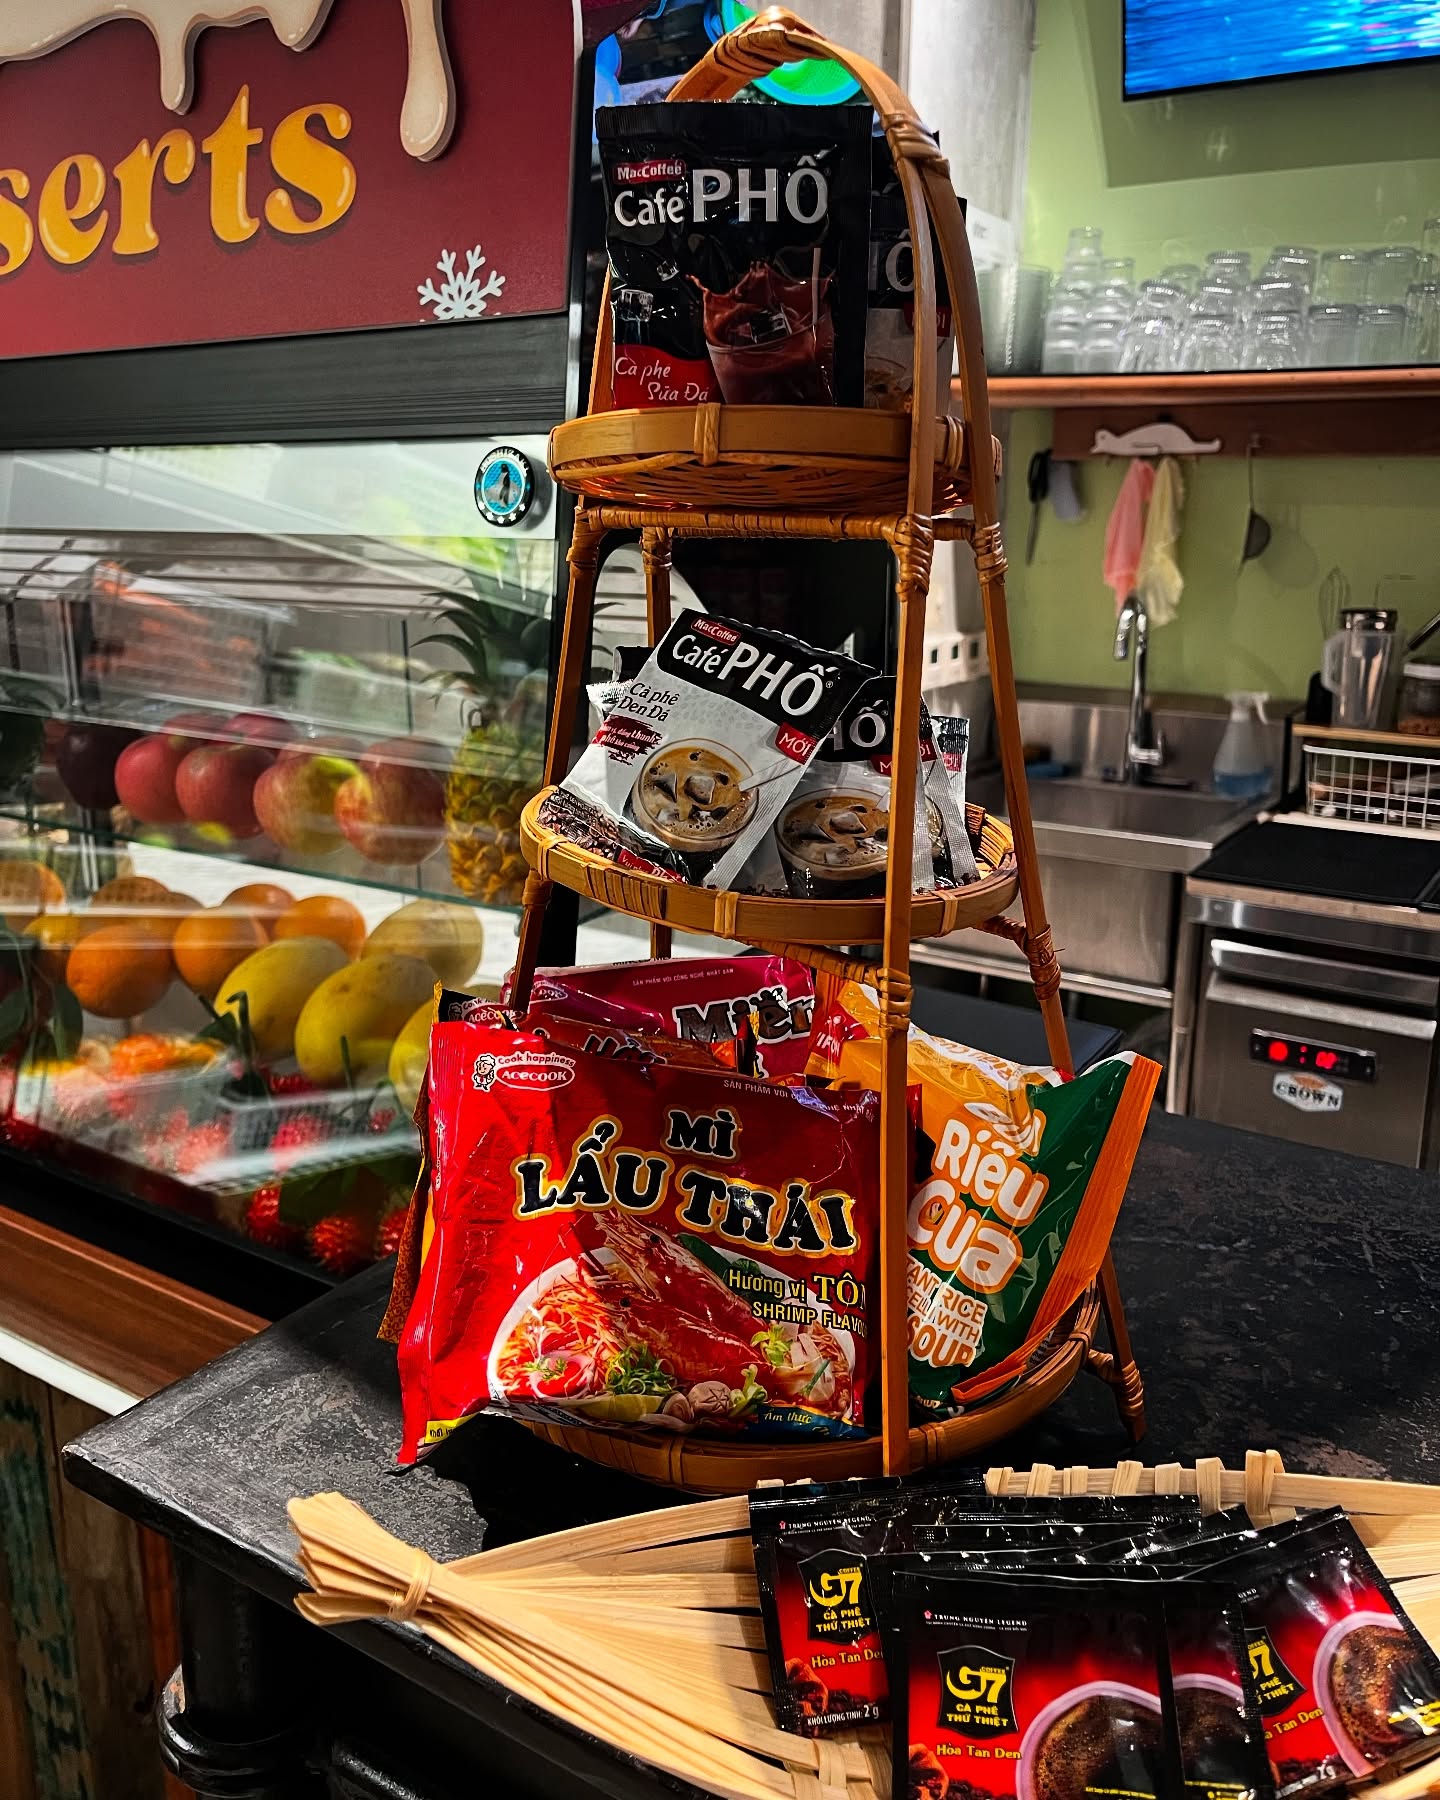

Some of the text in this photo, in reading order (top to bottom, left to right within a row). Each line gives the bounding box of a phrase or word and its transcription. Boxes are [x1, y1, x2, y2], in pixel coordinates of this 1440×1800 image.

[617, 163, 682, 180] MacCoffee
[614, 185, 684, 227] Café
[693, 618, 739, 643] MacCoffee
[672, 634, 839, 717] Café PHỐ
[629, 682, 681, 706] Cà phê
[498, 1052, 575, 1067] Cook happiness
[1276, 1081, 1339, 1107] CROWN
[666, 1108, 738, 1159] MÌ
[728, 1269, 783, 1298] Hương
[790, 1280, 805, 1301] vị
[752, 1301, 816, 1324] SHRIMP
[942, 1287, 986, 1324] RICE
[936, 1310, 980, 1344] WITH
[934, 1614, 960, 1622] TRUNG
[996, 1618, 1028, 1627] LEGEND
[811, 1653, 836, 1669] Hòa
[838, 1652, 861, 1665] Tan
[946, 1666, 1007, 1703] G7
[1273, 1717, 1298, 1735] Tan
[936, 1743, 962, 1756] Hòa
[966, 1745, 991, 1758] Tan
